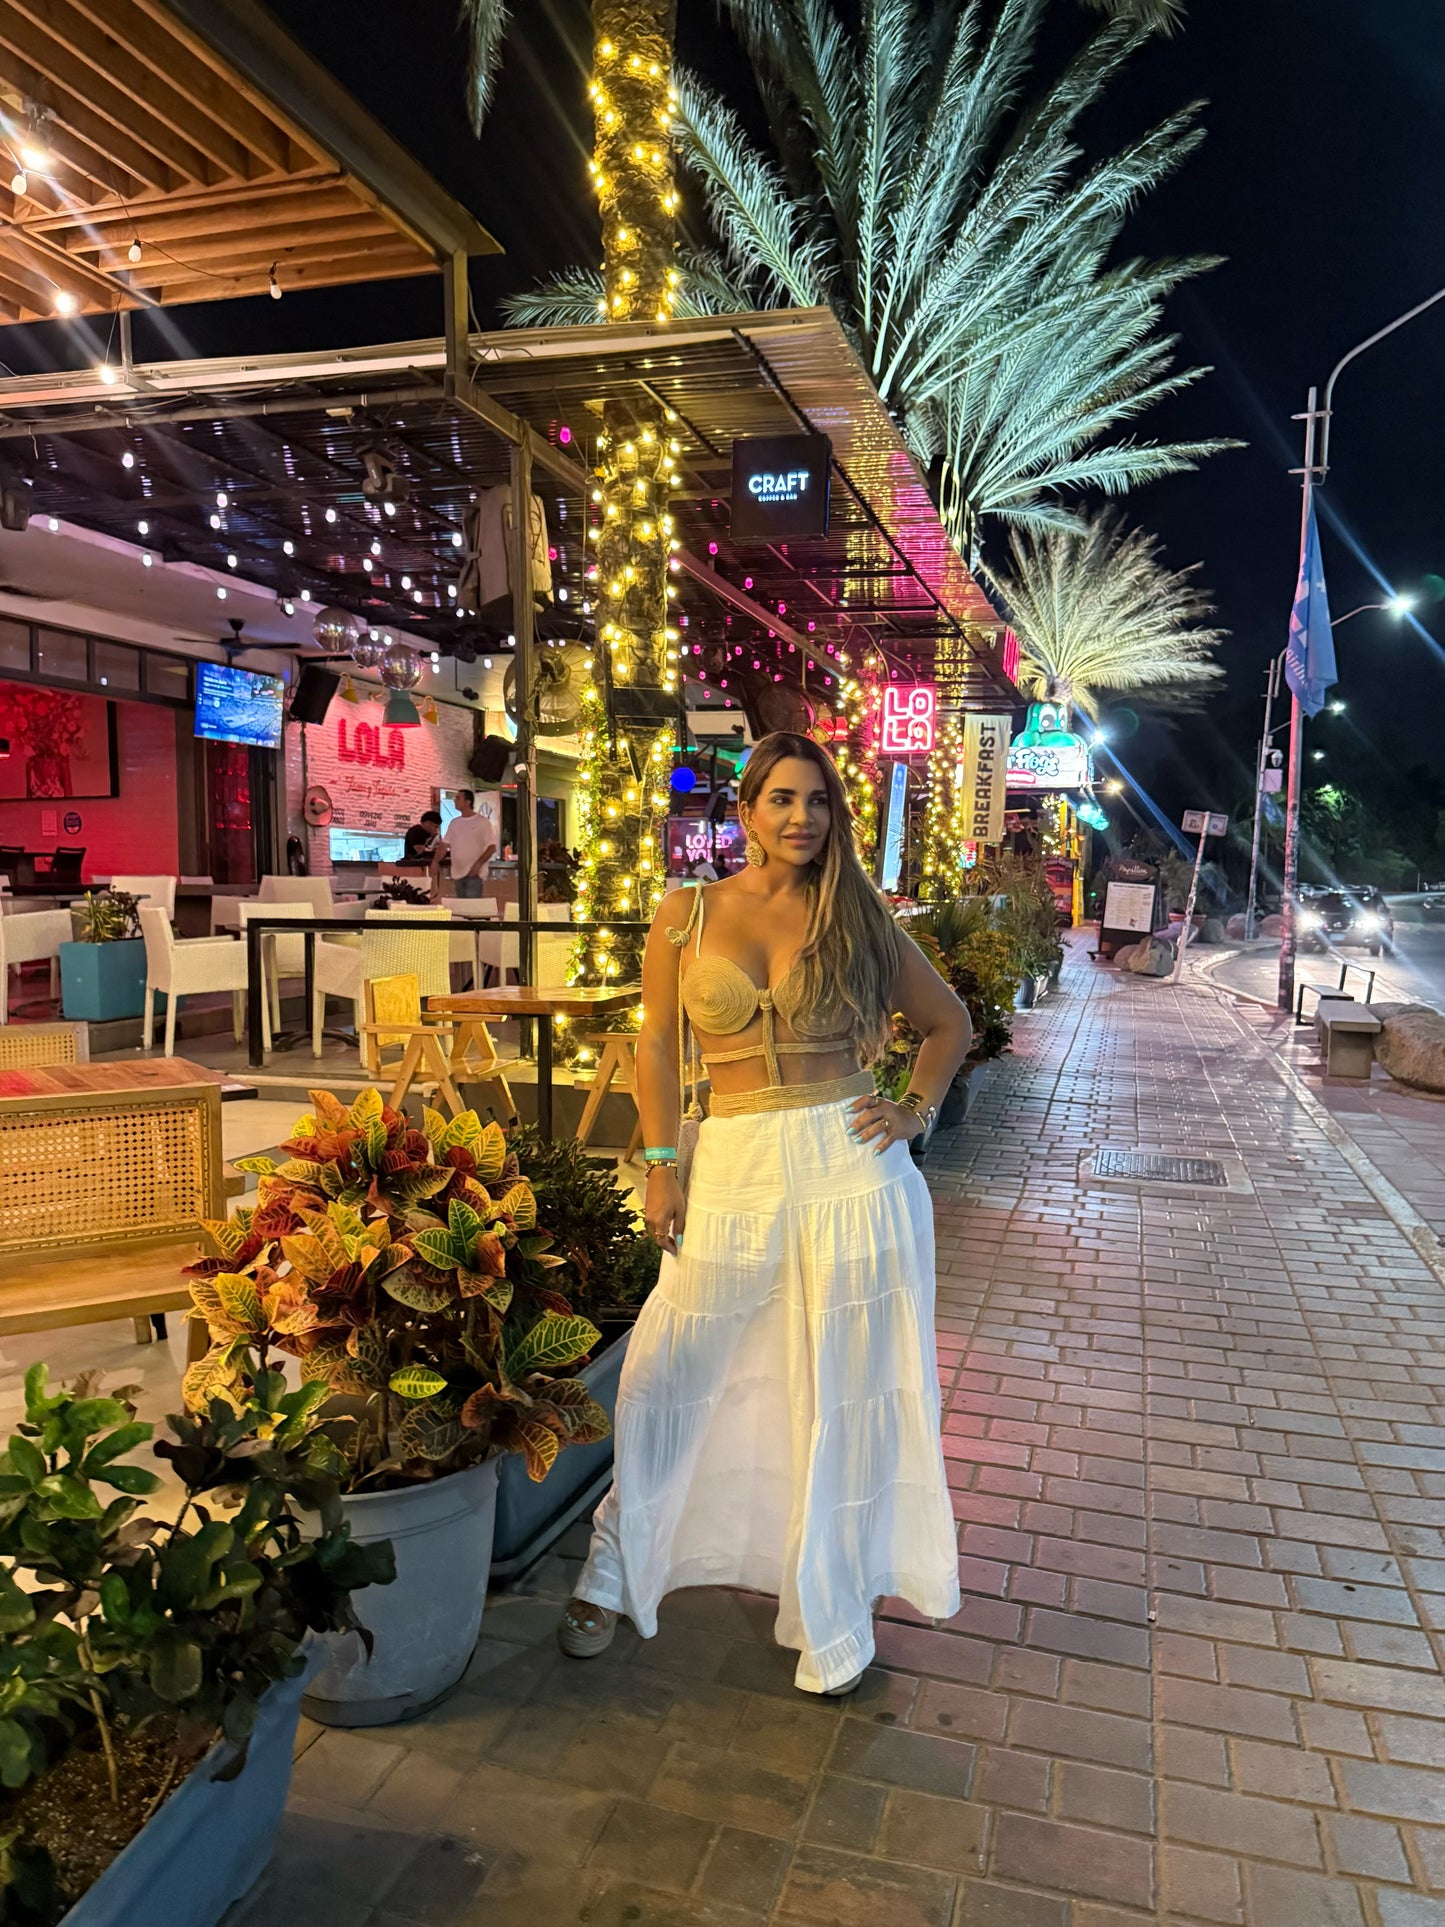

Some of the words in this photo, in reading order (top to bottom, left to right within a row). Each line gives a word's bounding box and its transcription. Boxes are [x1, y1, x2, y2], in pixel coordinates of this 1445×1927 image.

[748, 471, 809, 494] CRAFT
[337, 718, 406, 773] LOLA
[972, 721, 996, 838] BREAKFAST
